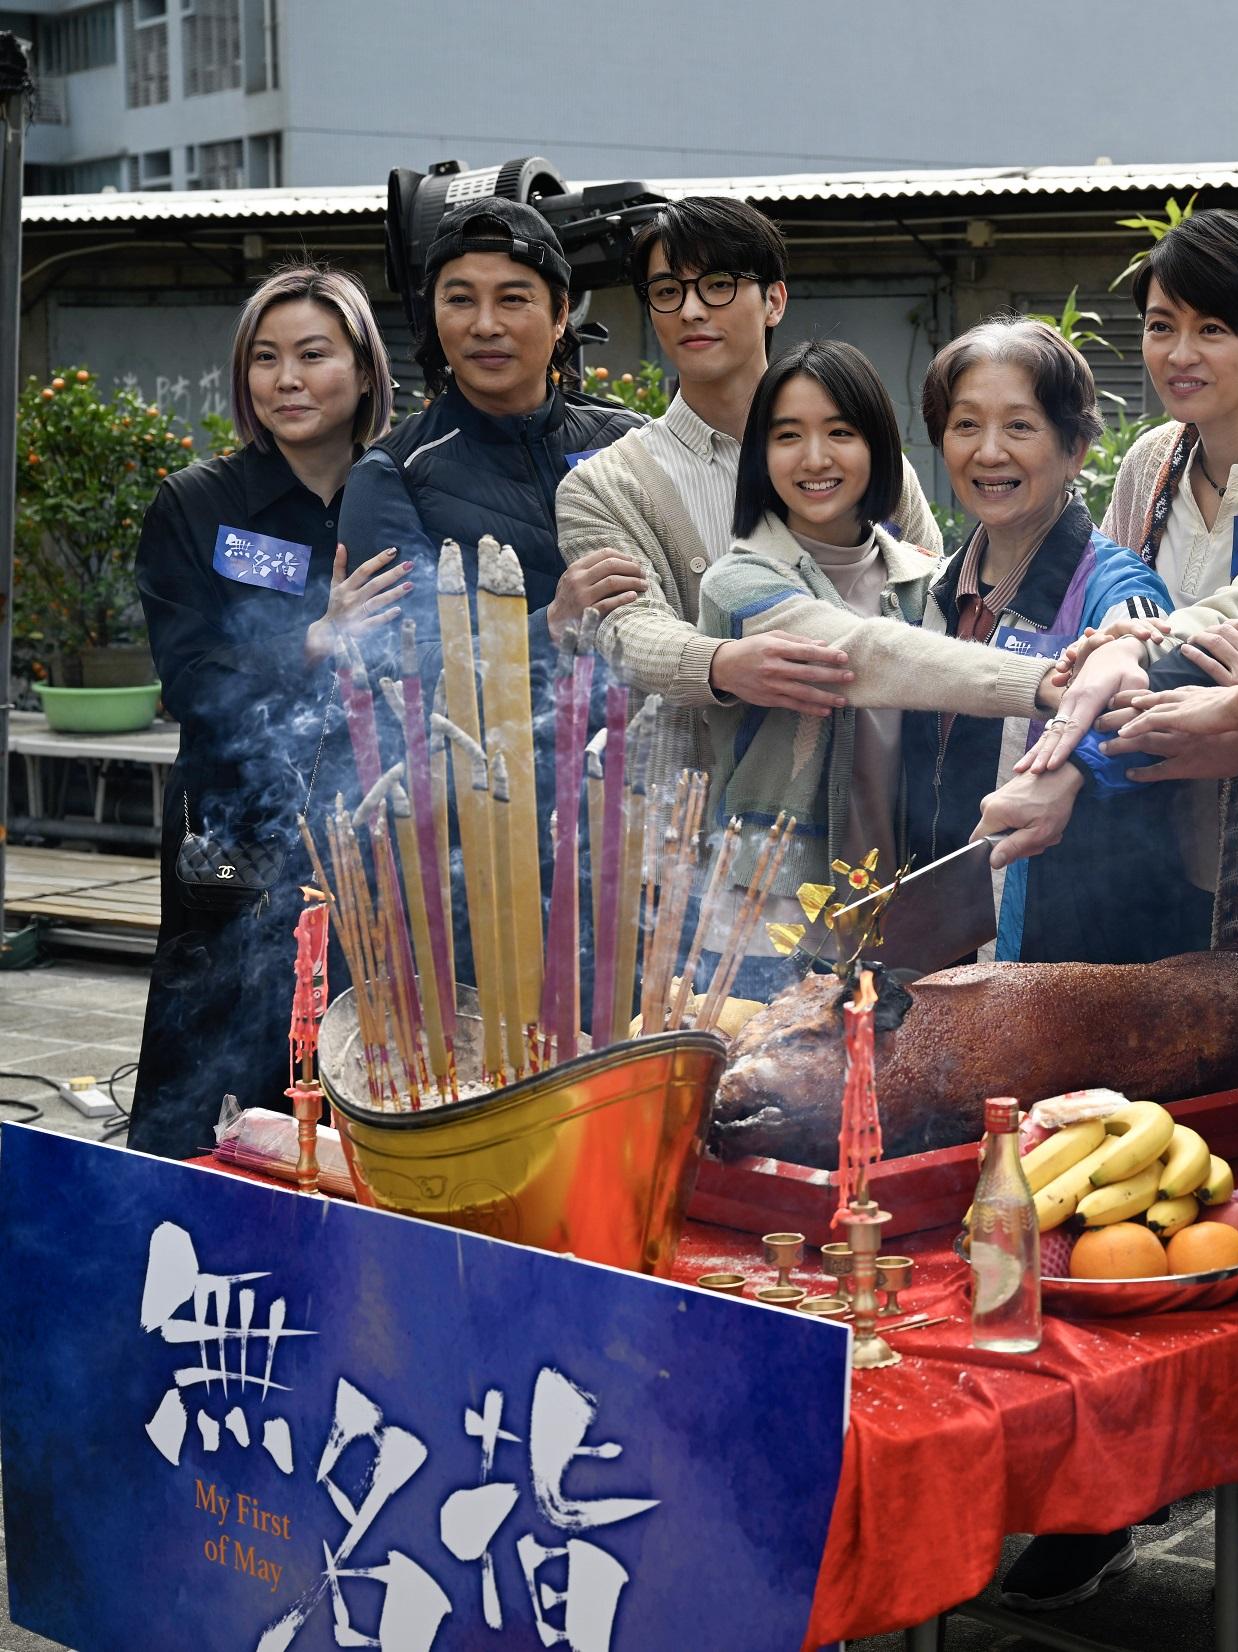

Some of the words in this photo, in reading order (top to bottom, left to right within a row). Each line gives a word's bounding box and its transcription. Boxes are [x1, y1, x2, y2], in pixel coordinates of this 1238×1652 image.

[224, 533, 302, 578] 無名指
[141, 1220, 661, 1652] 無名指
[195, 1478, 231, 1526] My
[236, 1492, 292, 1540] First
[204, 1534, 230, 1566] of
[234, 1540, 284, 1593] May
